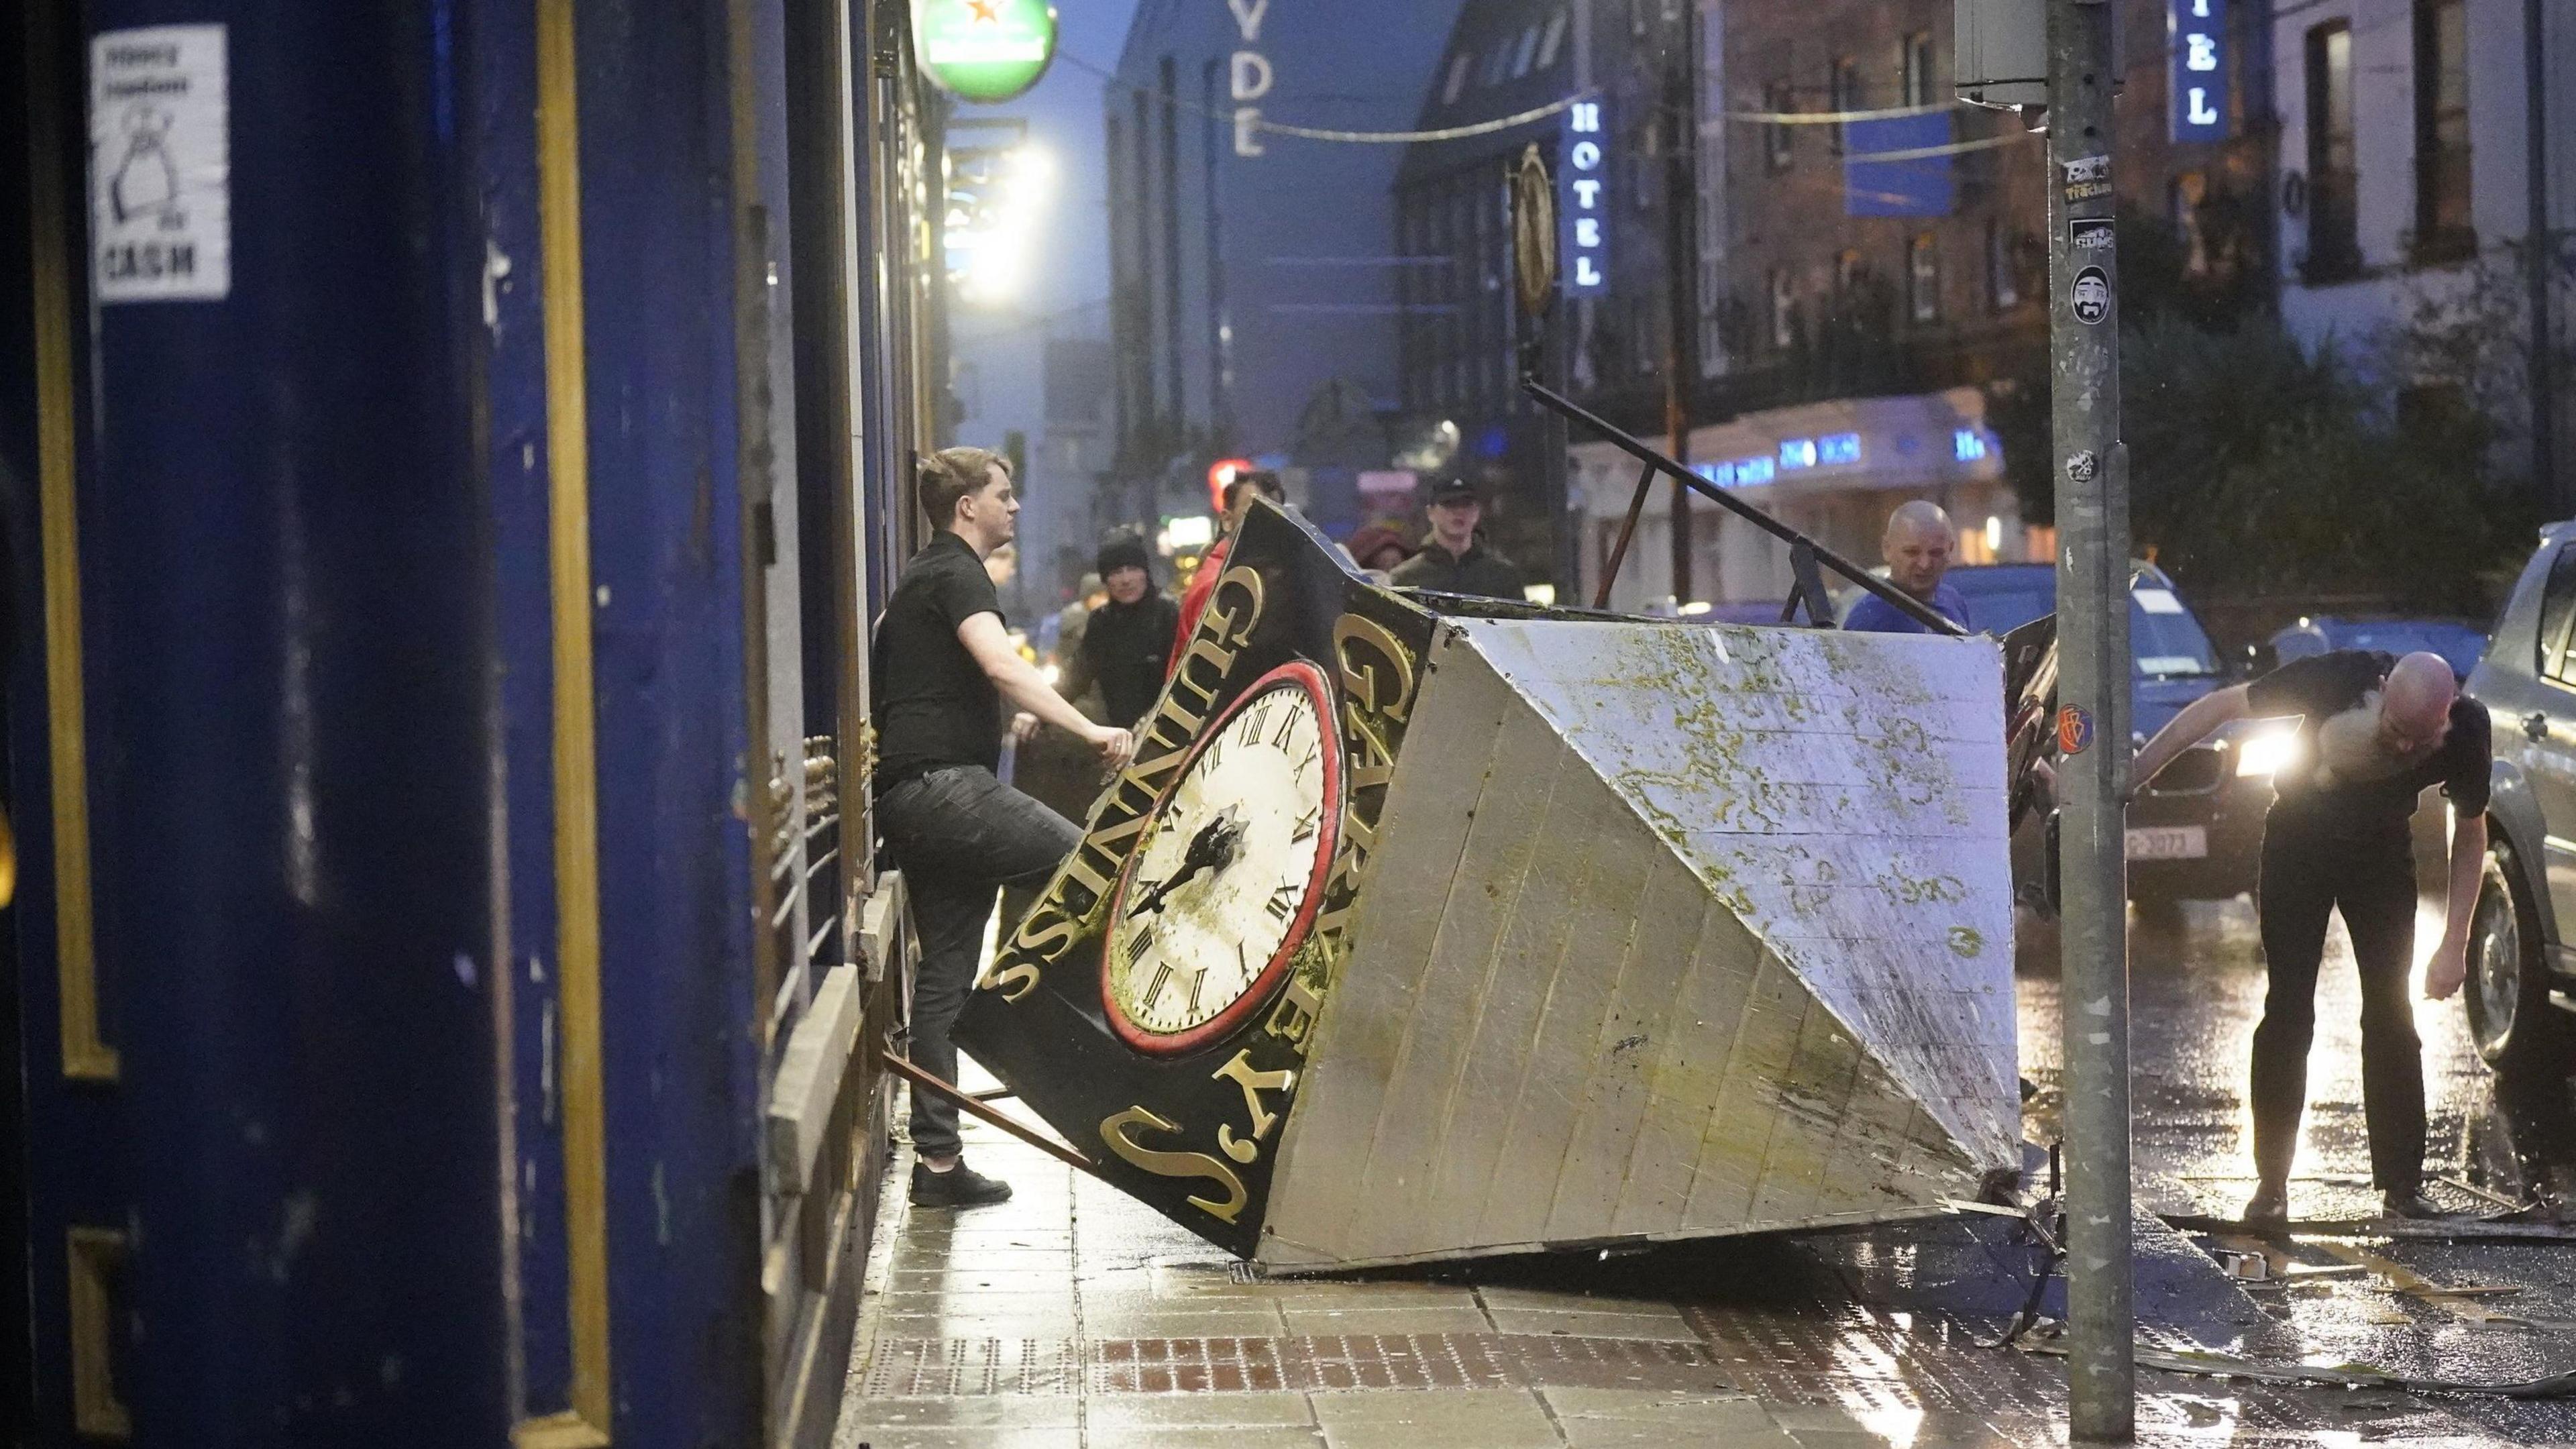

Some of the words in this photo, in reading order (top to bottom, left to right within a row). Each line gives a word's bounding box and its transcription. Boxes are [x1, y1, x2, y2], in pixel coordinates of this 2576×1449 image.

[1572, 102, 1601, 286] HOTEL
[1271, 704, 1304, 756] IX
[981, 565, 1266, 1005] GUINNESS
[1293, 740, 1317, 789] X
[1099, 612, 1415, 1225] GARVEY'S
[1264, 871, 1300, 925] XII
[1143, 961, 1175, 1010] III
[1187, 967, 1208, 1014] II
